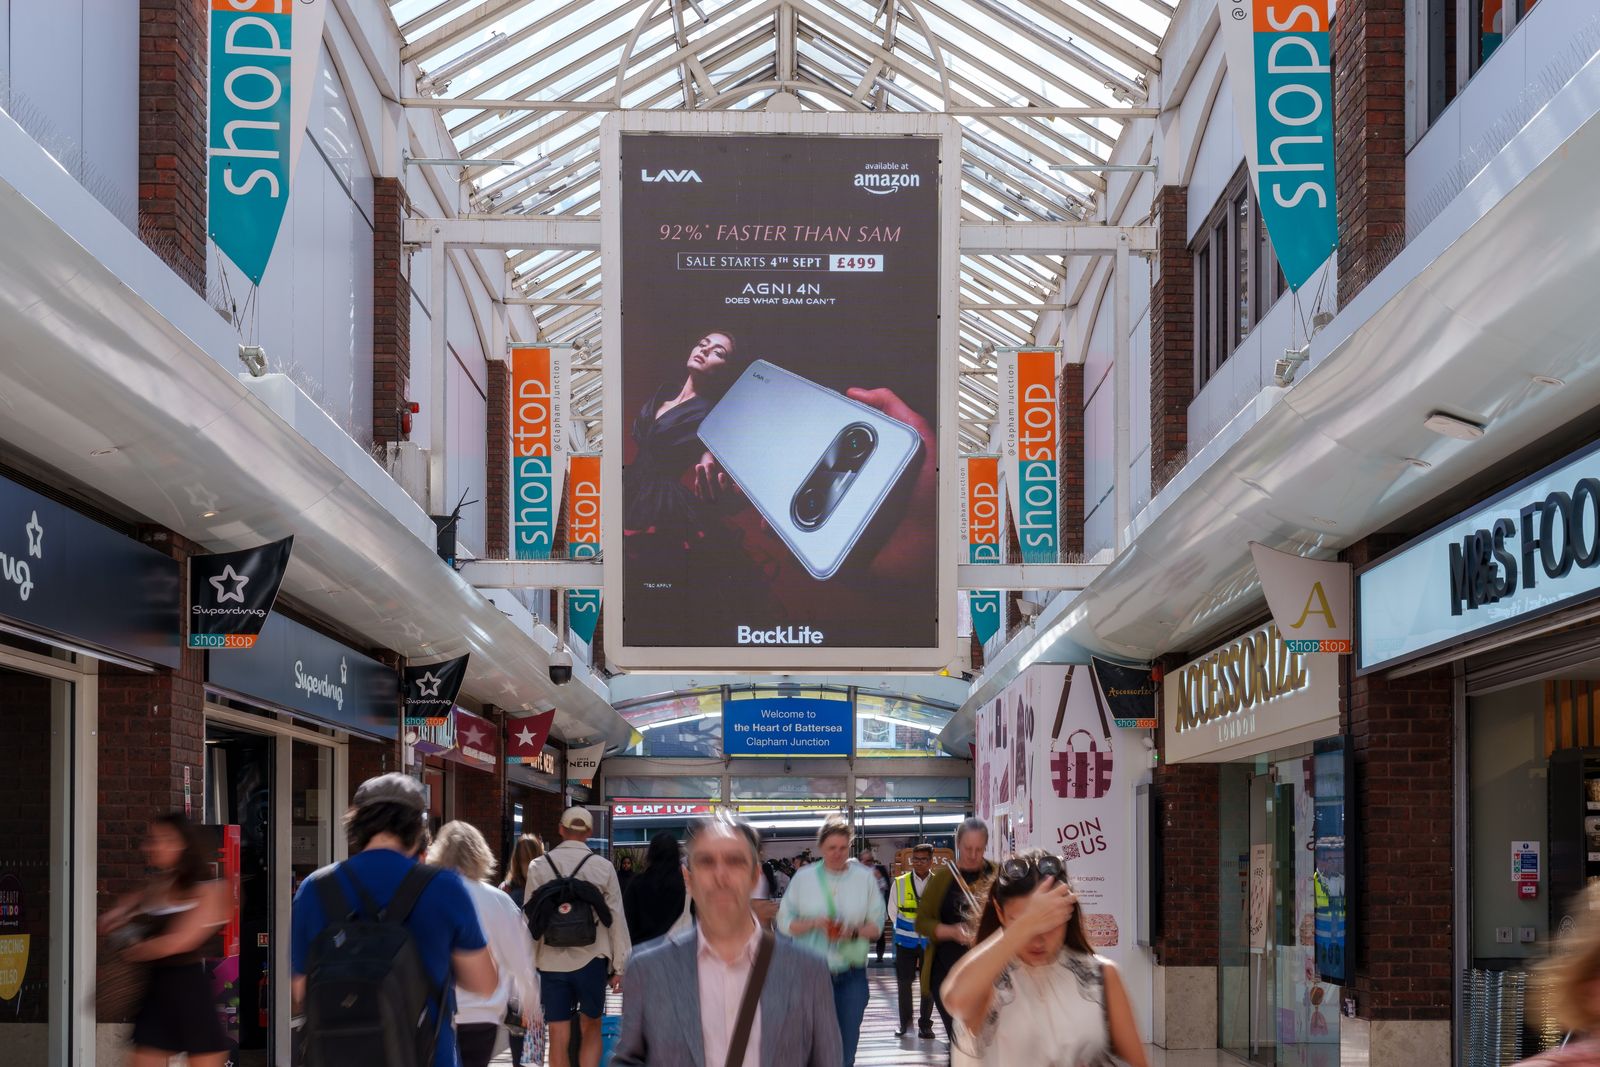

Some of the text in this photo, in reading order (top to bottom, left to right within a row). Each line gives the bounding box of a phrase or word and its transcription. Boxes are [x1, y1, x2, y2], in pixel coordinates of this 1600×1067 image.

[865, 162, 899, 170] available
[641, 169, 703, 183] LAVA
[854, 172, 920, 189] amazon
[716, 225, 787, 242] FASTER
[793, 225, 851, 242] THAN
[857, 226, 901, 242] SAM
[686, 256, 876, 269] SALE STARTS 4TH SEPT £499
[742, 283, 821, 295] AGNI 4N
[806, 297, 836, 305] CAN'T
[553, 404, 561, 452] @Clapham
[514, 379, 552, 545] shopstop
[1019, 383, 1056, 547] shopstop
[1449, 518, 1518, 616] M&S
[191, 605, 267, 618] Superdrug
[1289, 581, 1337, 629] A
[194, 633, 253, 649] shopstop
[737, 625, 824, 644] BackLite
[1289, 639, 1346, 654] shopstop
[294, 659, 344, 710] Superdrug
[406, 697, 452, 705] Superdrug
[760, 709, 817, 719] Welcome to
[406, 717, 444, 727] shopstop
[734, 723, 843, 733] the Heart of Battersea
[1117, 719, 1154, 728] shopstop
[1218, 714, 1256, 743] LONDON
[746, 737, 830, 749] Clapham Junction
[569, 760, 596, 768] NERO
[1056, 816, 1102, 844] JOIN
[1080, 834, 1107, 856] US
